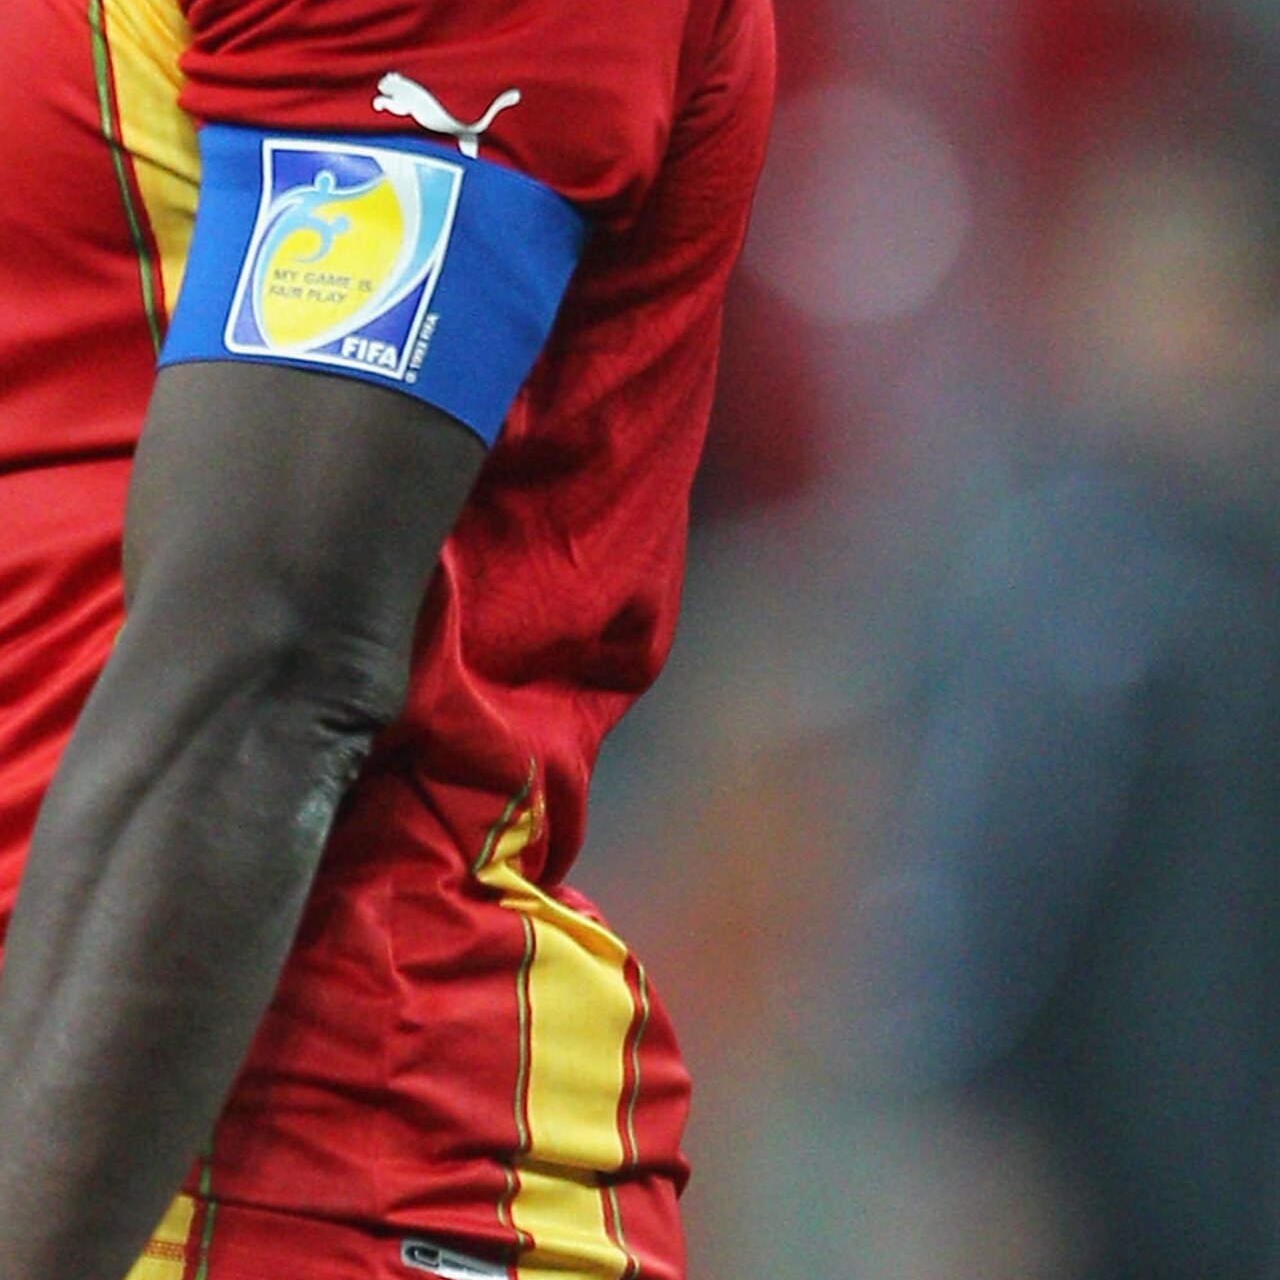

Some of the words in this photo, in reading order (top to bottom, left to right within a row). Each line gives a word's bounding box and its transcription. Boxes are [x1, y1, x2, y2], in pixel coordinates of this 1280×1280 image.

[274, 269, 298, 280] MY
[304, 272, 351, 289] GAME
[306, 288, 348, 303] PLAY
[342, 335, 398, 371] FIFA
